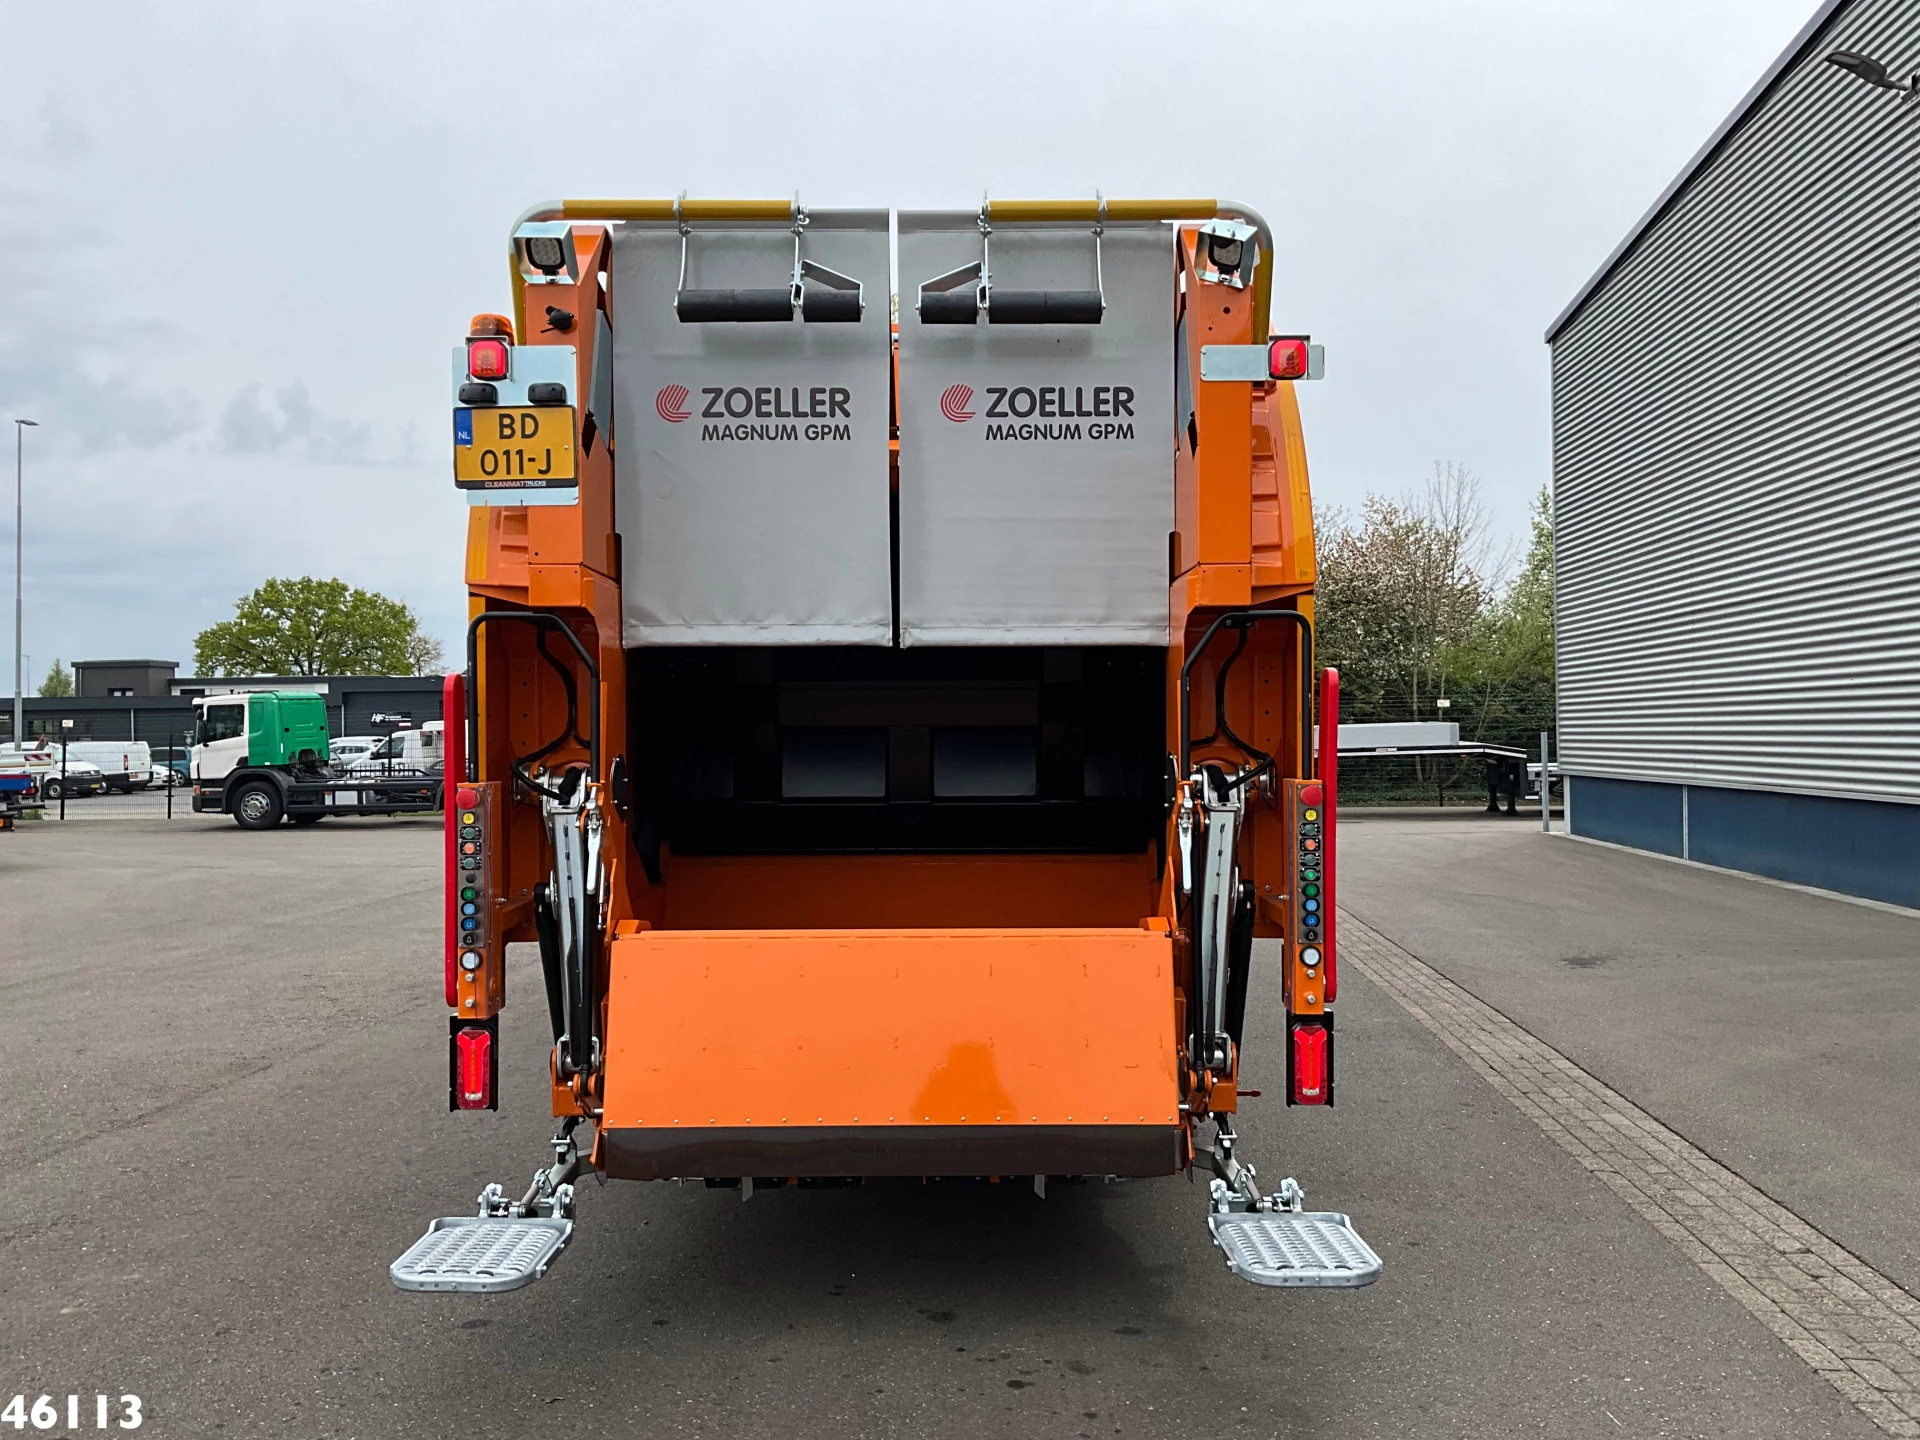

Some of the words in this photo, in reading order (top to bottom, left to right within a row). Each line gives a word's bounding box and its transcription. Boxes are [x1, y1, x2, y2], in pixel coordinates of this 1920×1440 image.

[701, 387, 851, 418] ZOELLER
[985, 386, 1135, 418] ZOELLER
[458, 431, 471, 440] NL
[498, 412, 540, 440] BD
[701, 424, 799, 441] MAGNUM
[804, 424, 851, 441] GPM
[985, 423, 1082, 441] MAGNUM
[1087, 423, 1135, 440] GPM
[480, 448, 552, 476] 011-J
